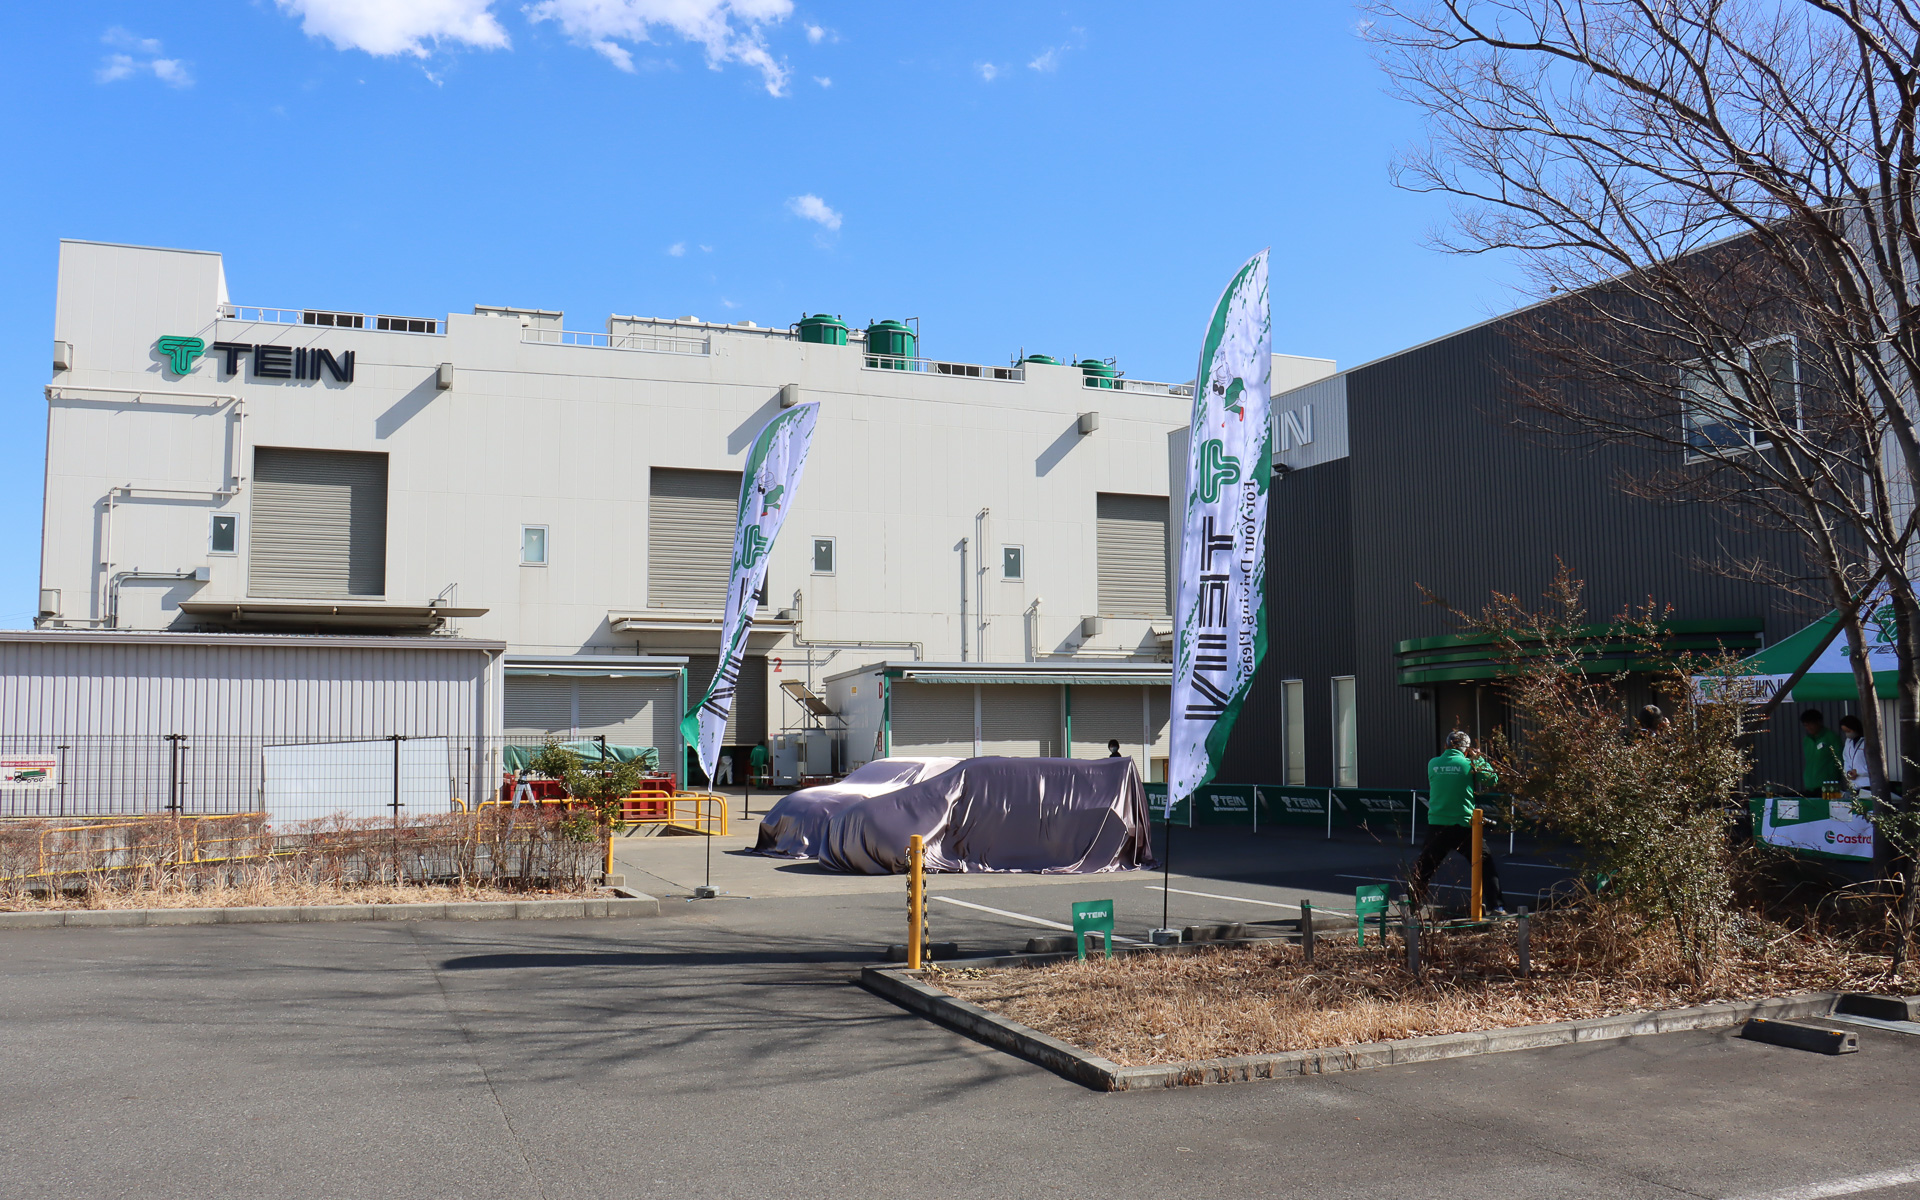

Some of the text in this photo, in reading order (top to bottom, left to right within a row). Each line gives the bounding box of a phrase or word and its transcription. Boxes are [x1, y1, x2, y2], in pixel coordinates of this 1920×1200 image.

[213, 341, 355, 383] TEIN
[1271, 404, 1314, 454] IN
[773, 656, 783, 673] 2
[1219, 795, 1247, 806] TEIN
[1290, 797, 1322, 809] TEIN
[1086, 911, 1107, 919] TEIN
